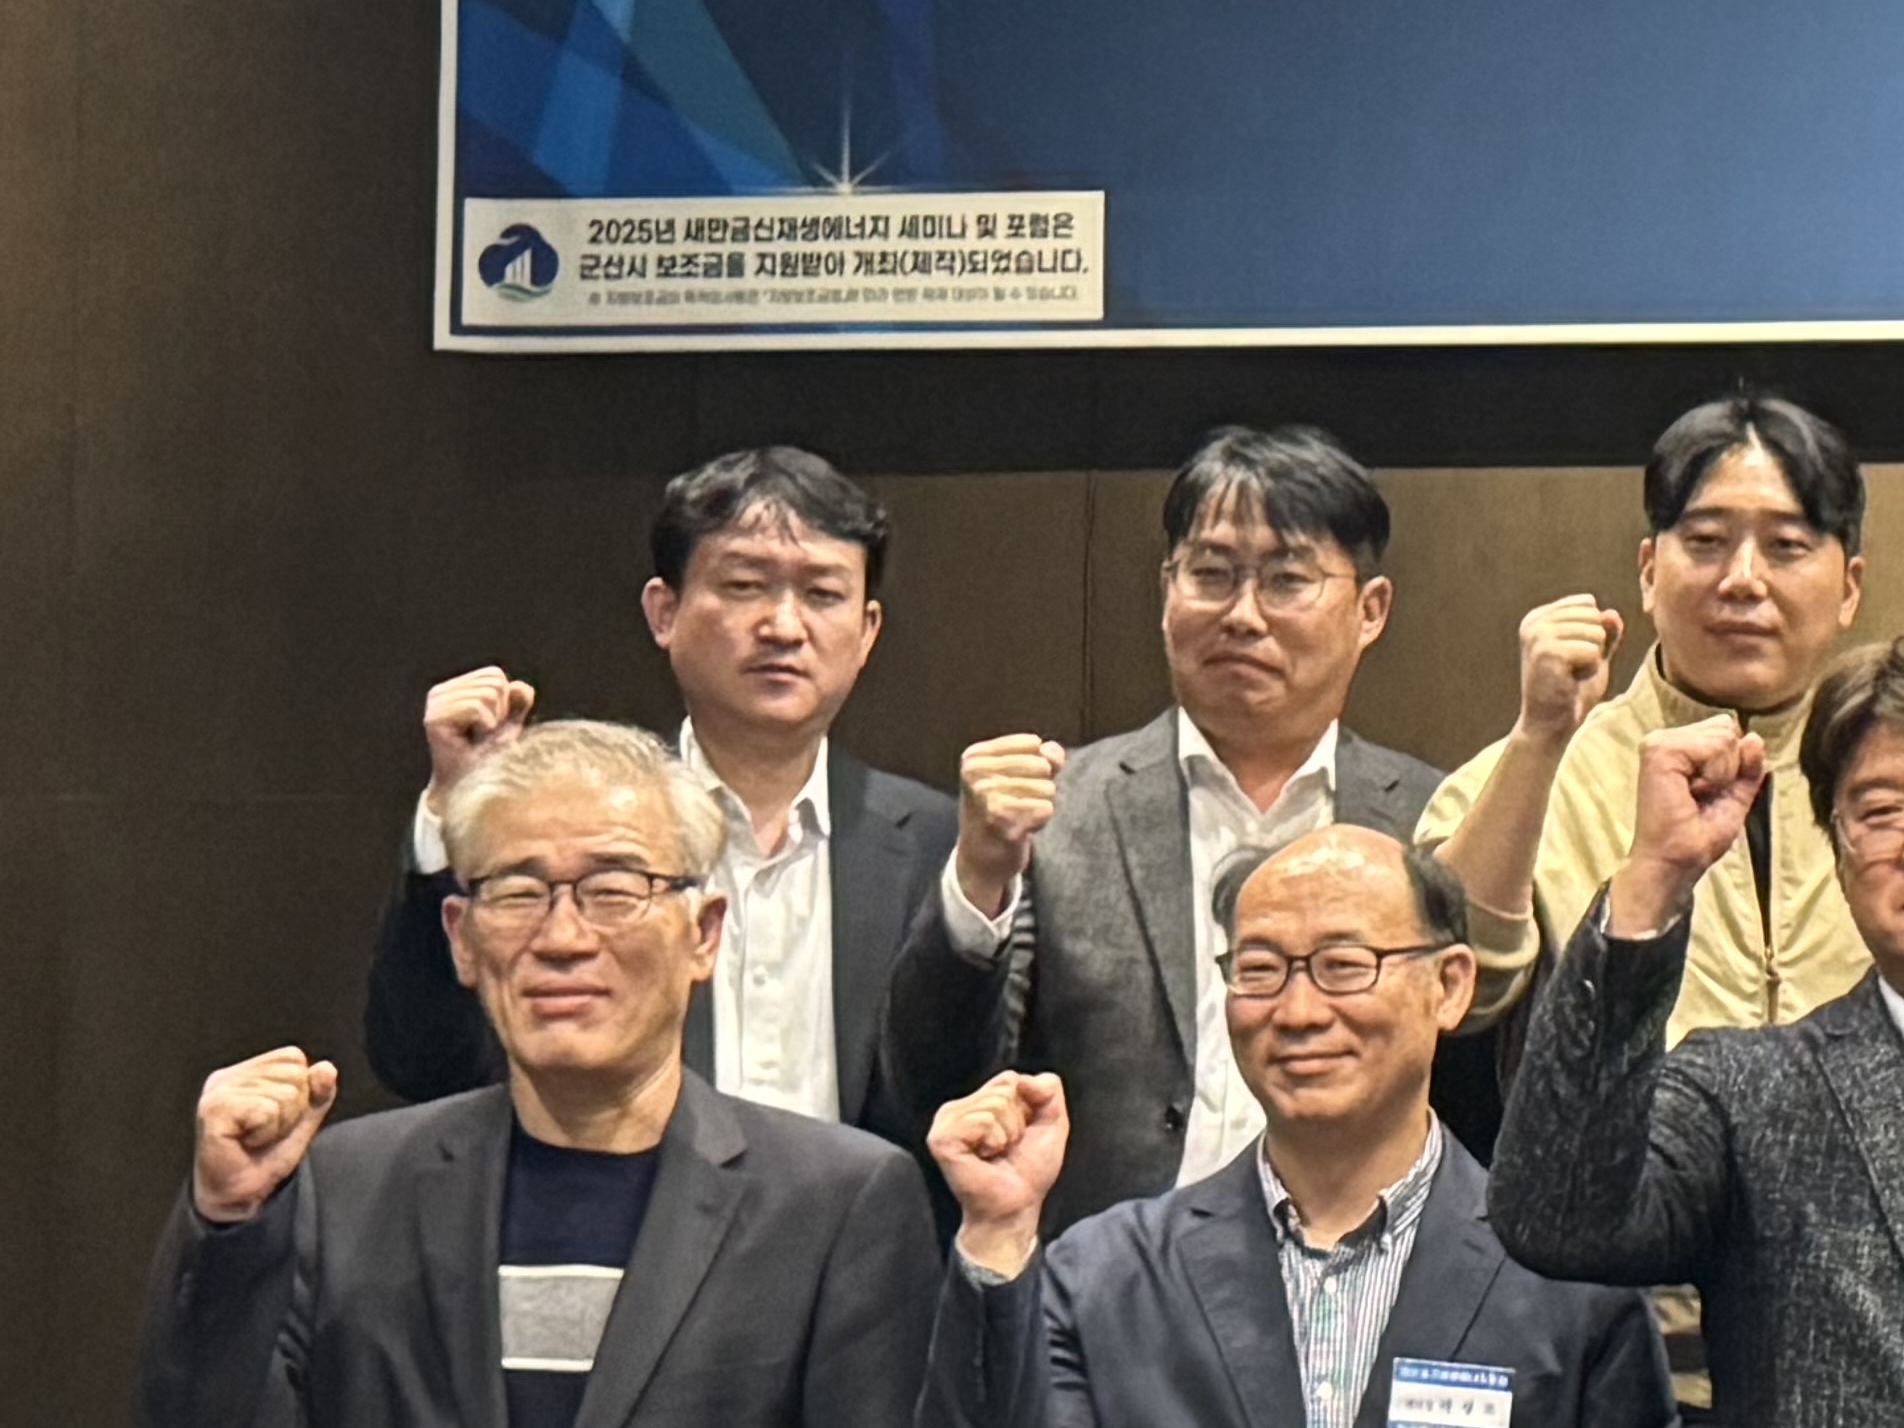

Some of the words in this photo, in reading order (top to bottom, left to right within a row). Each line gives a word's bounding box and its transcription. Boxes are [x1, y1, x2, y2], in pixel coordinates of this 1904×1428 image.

[588, 218, 675, 245] 2025년
[683, 215, 889, 244] 새만금신재생에너지
[898, 215, 967, 240] 세미나
[976, 214, 997, 239] 및
[1006, 213, 1073, 239] 포럼은
[579, 254, 647, 281] 군산시
[754, 252, 845, 278] 지원받아
